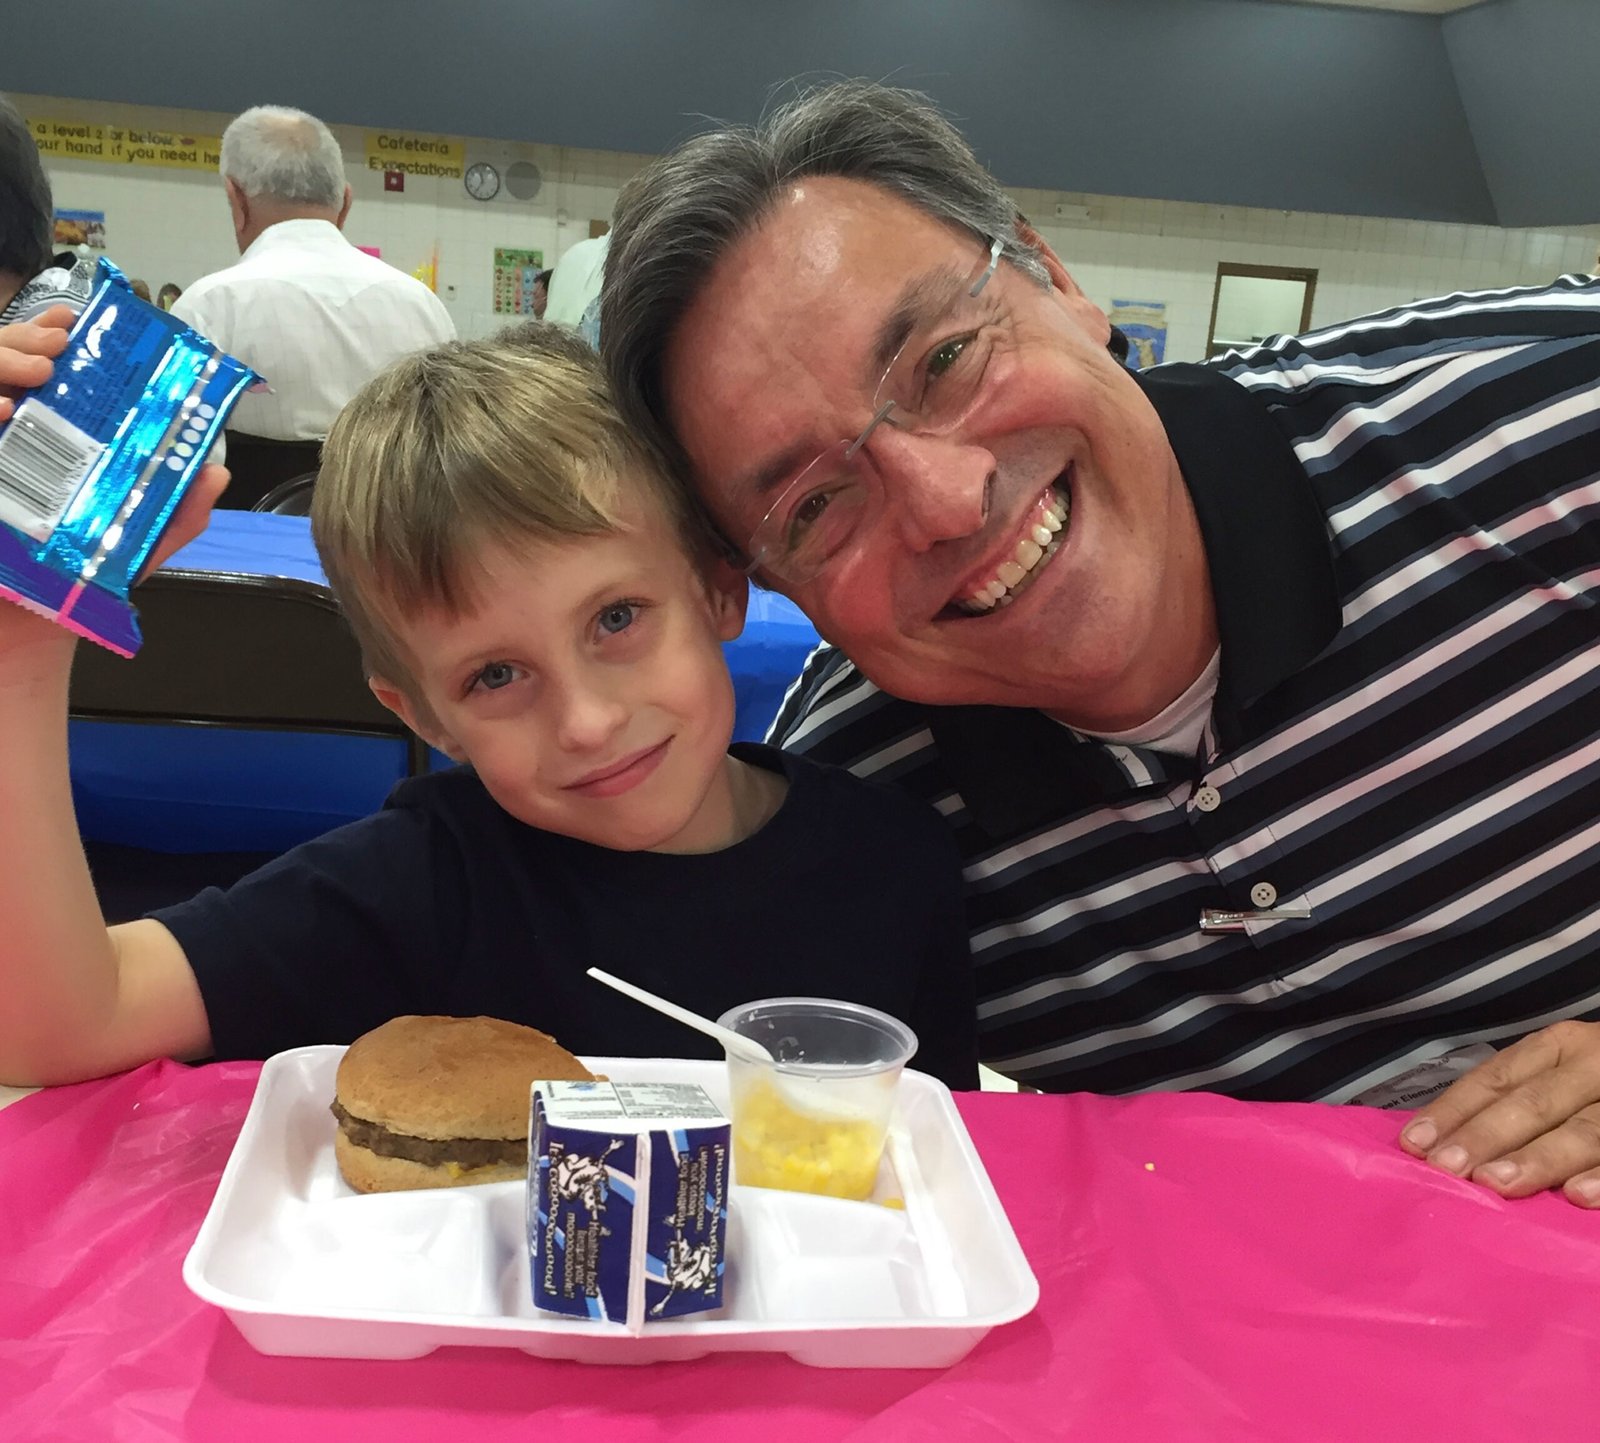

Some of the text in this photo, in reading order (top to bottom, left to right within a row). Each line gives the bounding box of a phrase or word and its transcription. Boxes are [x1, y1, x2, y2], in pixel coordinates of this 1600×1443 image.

[36, 123, 47, 134] a
[53, 124, 91, 138] level
[110, 130, 124, 140] or
[128, 130, 173, 146] below
[377, 135, 449, 154] Cafeteria
[35, 138, 220, 165] our hand if you need he
[368, 156, 461, 179] Expectations
[676, 1153, 689, 1228] Healthier food
[687, 1162, 699, 1216] keeps you
